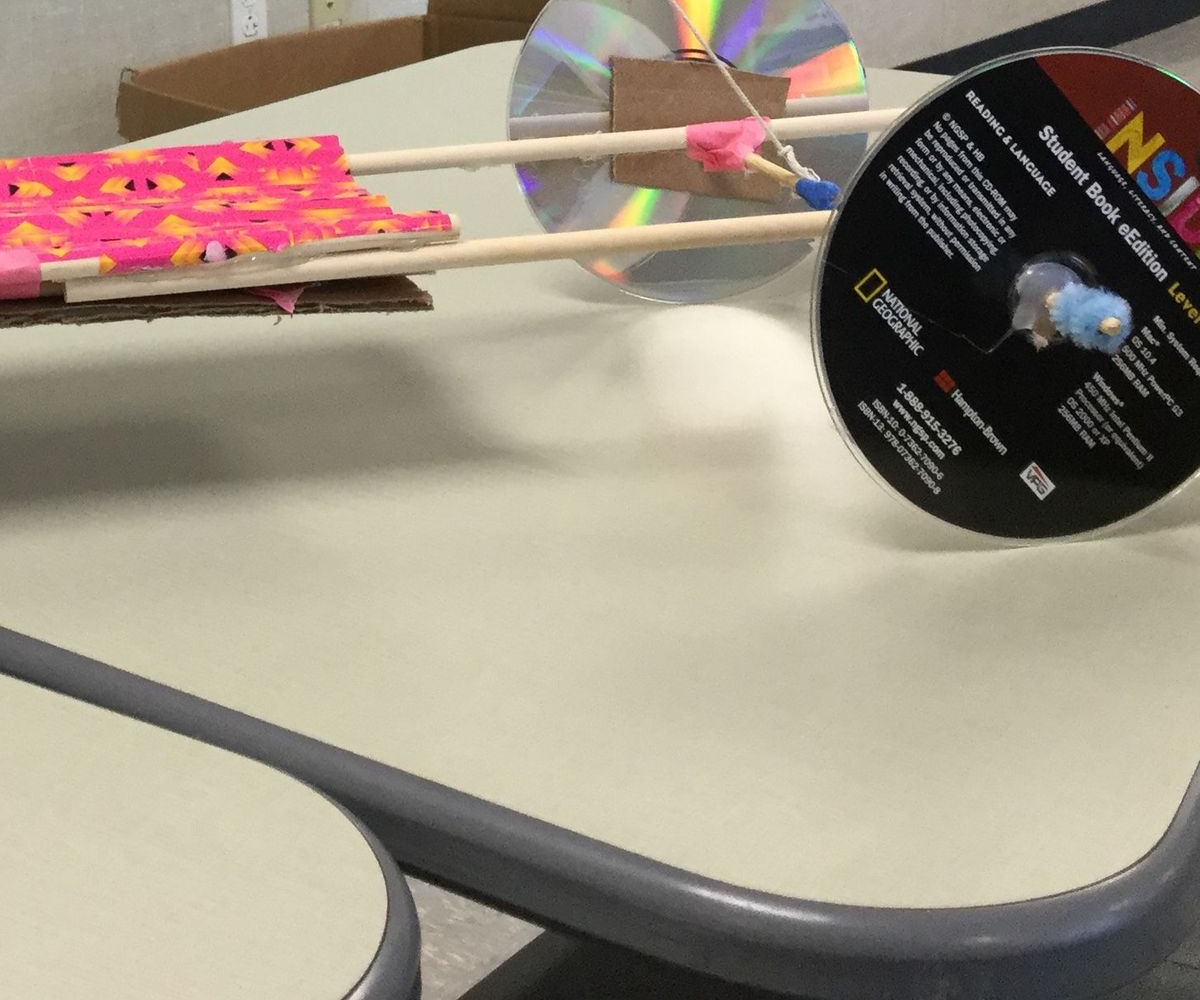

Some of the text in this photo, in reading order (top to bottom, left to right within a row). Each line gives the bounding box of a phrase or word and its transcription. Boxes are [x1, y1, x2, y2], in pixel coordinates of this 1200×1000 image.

[932, 120, 1018, 222] No pages from this CD-ROM may
[948, 119, 969, 143] NGSP
[965, 140, 975, 150] &
[971, 148, 985, 162] HB
[964, 90, 1056, 197] READING & LANGUAGE
[884, 178, 907, 202] writing
[903, 199, 921, 218] from
[916, 215, 930, 229] the
[914, 137, 931, 156] form
[971, 204, 1001, 237] electronic
[996, 235, 1006, 245] or
[930, 138, 1017, 239] reproduced transmitted in any
[936, 183, 965, 214] including
[1036, 123, 1092, 186] Student
[1084, 181, 1124, 224] Book
[1116, 219, 1172, 282] eEdition
[1094, 98, 1200, 262] INSID
[887, 162, 913, 191] retrieval
[929, 212, 953, 238] without
[949, 236, 982, 273] permission
[936, 200, 970, 239] information
[966, 237, 990, 263] storage
[870, 295, 925, 358] GEOGRAPHIC
[880, 287, 924, 336] NATIONAL
[1130, 334, 1143, 349] OS
[856, 400, 886, 433] ISBN-13:
[870, 397, 900, 431] ISBN-10:
[895, 380, 963, 457] 1-888-915-3276
[1132, 378, 1150, 398] RAM
[891, 398, 945, 460] www.ngsp.com
[947, 388, 1009, 458] Hampton-Brown
